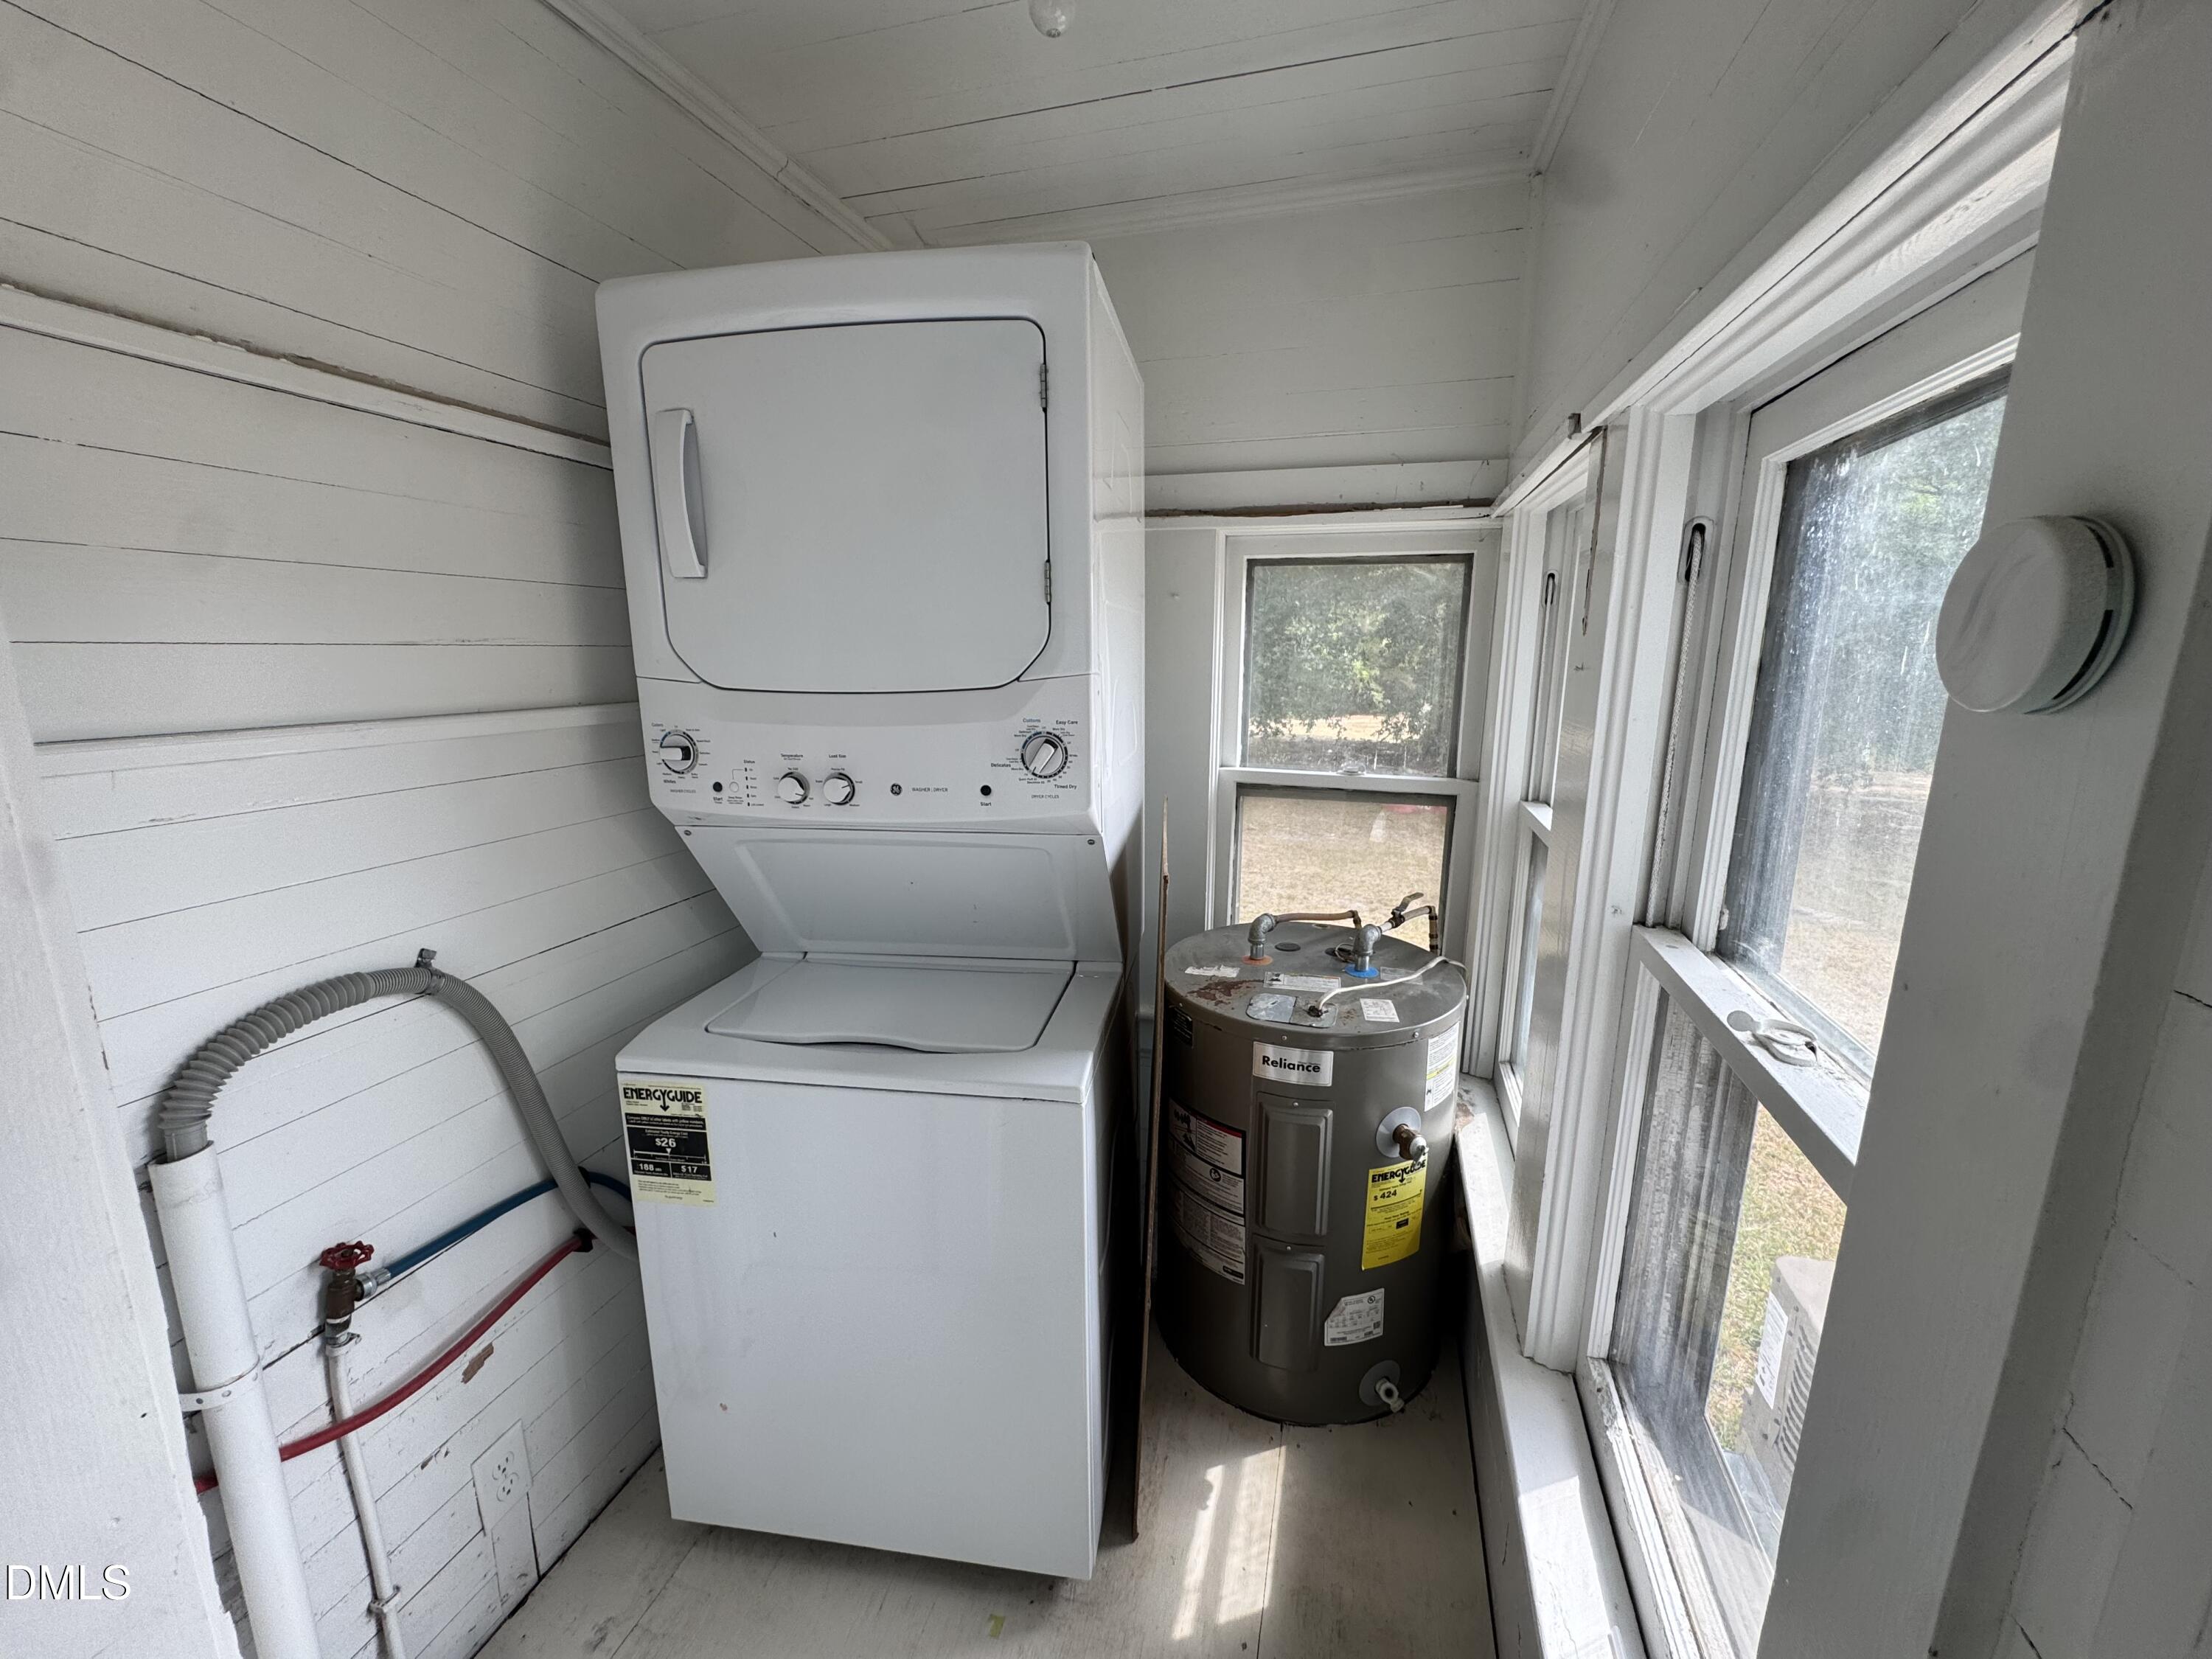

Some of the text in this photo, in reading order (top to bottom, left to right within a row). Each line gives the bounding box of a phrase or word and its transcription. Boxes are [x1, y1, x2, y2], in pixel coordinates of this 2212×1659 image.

[1262, 1055, 1321, 1073] Reliance
[623, 1087, 703, 1104] ENERGYGUIDE
[1380, 1189, 1397, 1199] 424
